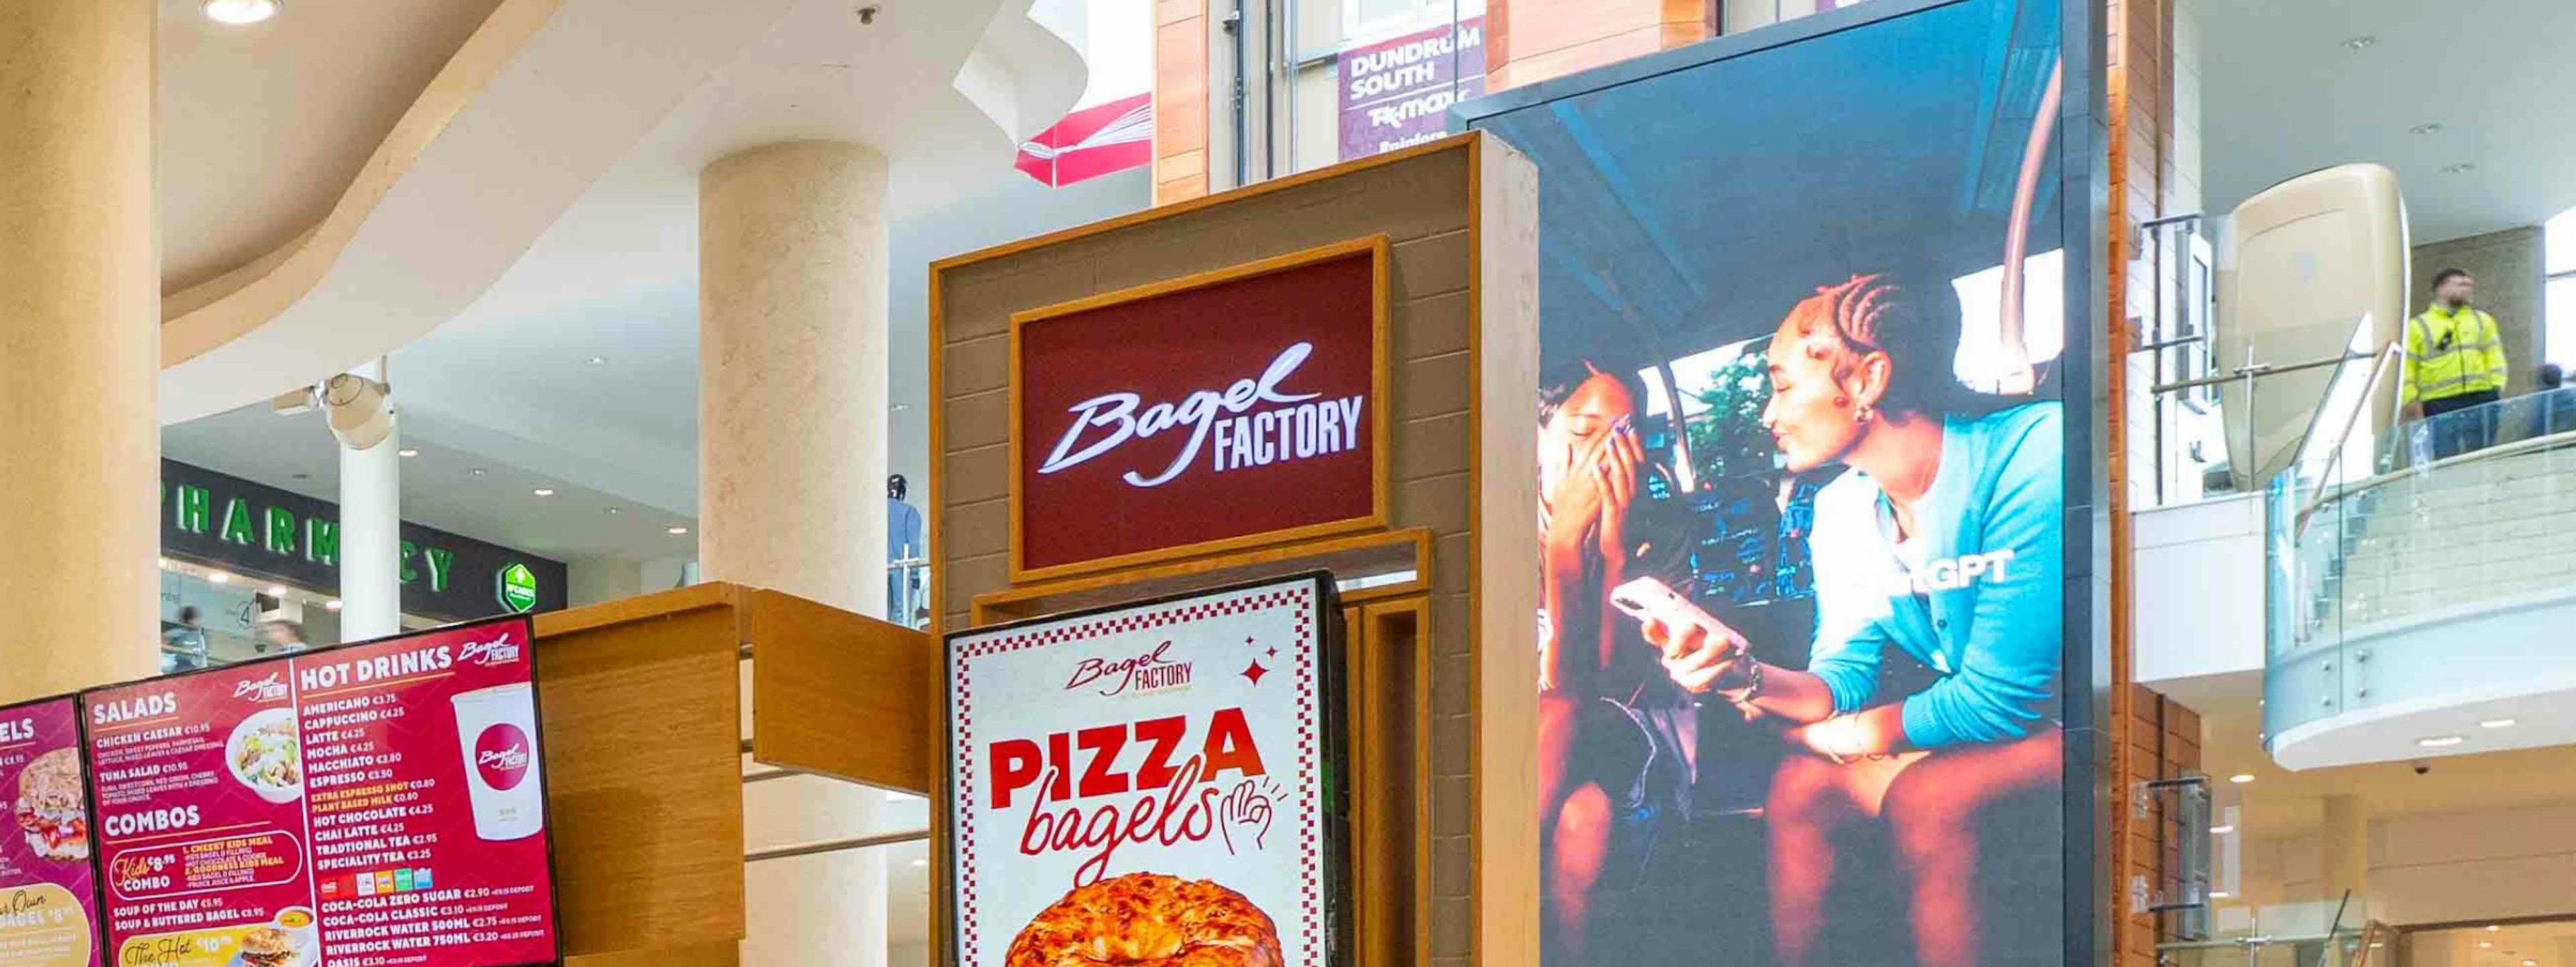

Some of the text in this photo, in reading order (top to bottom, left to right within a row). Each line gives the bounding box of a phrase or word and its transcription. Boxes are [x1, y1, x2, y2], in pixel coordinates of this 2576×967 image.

[1350, 27, 1481, 78] DUNDRUM
[1350, 61, 1435, 100] SOUTH
[1037, 342, 1322, 488] Bagel
[1214, 395, 1363, 472] FACTORY
[457, 632, 509, 665] Bagel
[490, 643, 521, 662] FACTORY
[301, 645, 452, 691] HOT DRINKS
[1064, 640, 1176, 697] Bagel
[1135, 662, 1193, 691] FACTORY
[93, 691, 177, 725] SALADS
[303, 696, 370, 717] AMERICANO
[372, 693, 396, 705] €3.75
[304, 707, 405, 731] CAPPUCCINO €4.25
[97, 731, 142, 748] CHICKEN
[143, 725, 182, 742] CAESAR
[305, 731, 339, 745] LATTE
[307, 744, 348, 760] MOCHA
[478, 743, 519, 769] Bagel
[989, 707, 1267, 809] PIZZA
[100, 762, 188, 782] TUNA SALAD €10.95
[308, 756, 374, 774] MACCHIATO
[309, 772, 366, 788] ESPRESSO
[311, 791, 339, 803] EXTRA
[339, 786, 384, 799] ESPRESSO
[385, 782, 409, 793] SHOT
[105, 805, 200, 836] COMBOS
[314, 804, 433, 827] HOT CHOCOLATE €4.25
[1020, 754, 1219, 888] bagels
[191, 841, 225, 853] CHEEKY
[227, 838, 247, 849] KIDS
[248, 835, 273, 846] MEAL
[315, 822, 405, 842] CHAI LATTE €4.25
[388, 835, 411, 848] TEA
[413, 833, 437, 845] €2.95
[114, 856, 150, 887] Kids
[317, 852, 381, 870] SPECIALITY
[382, 850, 405, 863] TEA
[123, 875, 170, 891] COMBO
[114, 904, 140, 917] SOUP
[142, 901, 156, 914] OF
[157, 899, 178, 912] THE
[180, 897, 199, 911] DAY
[321, 897, 388, 913] COCA-COLA
[390, 894, 420, 907] ZERO
[422, 888, 462, 903] SUGAR
[464, 886, 490, 899] €2.90
[115, 917, 142, 931] SOUP
[144, 917, 151, 929] &
[152, 910, 204, 927] BUTTERED
[206, 907, 239, 923] BAGEL
[323, 912, 389, 927] COCA-COLA
[390, 906, 438, 921] CLASSIC
[324, 927, 390, 942] RIVERROCK
[391, 923, 430, 936] WATER
[432, 918, 471, 931] 500ML
[473, 916, 497, 927] €2.75
[124, 941, 156, 966] The
[157, 935, 193, 967] Hot
[325, 941, 391, 956] RIVERROCK
[392, 935, 431, 949] WATER
[433, 931, 471, 946] 750ML
[327, 956, 360, 967] OASIS
